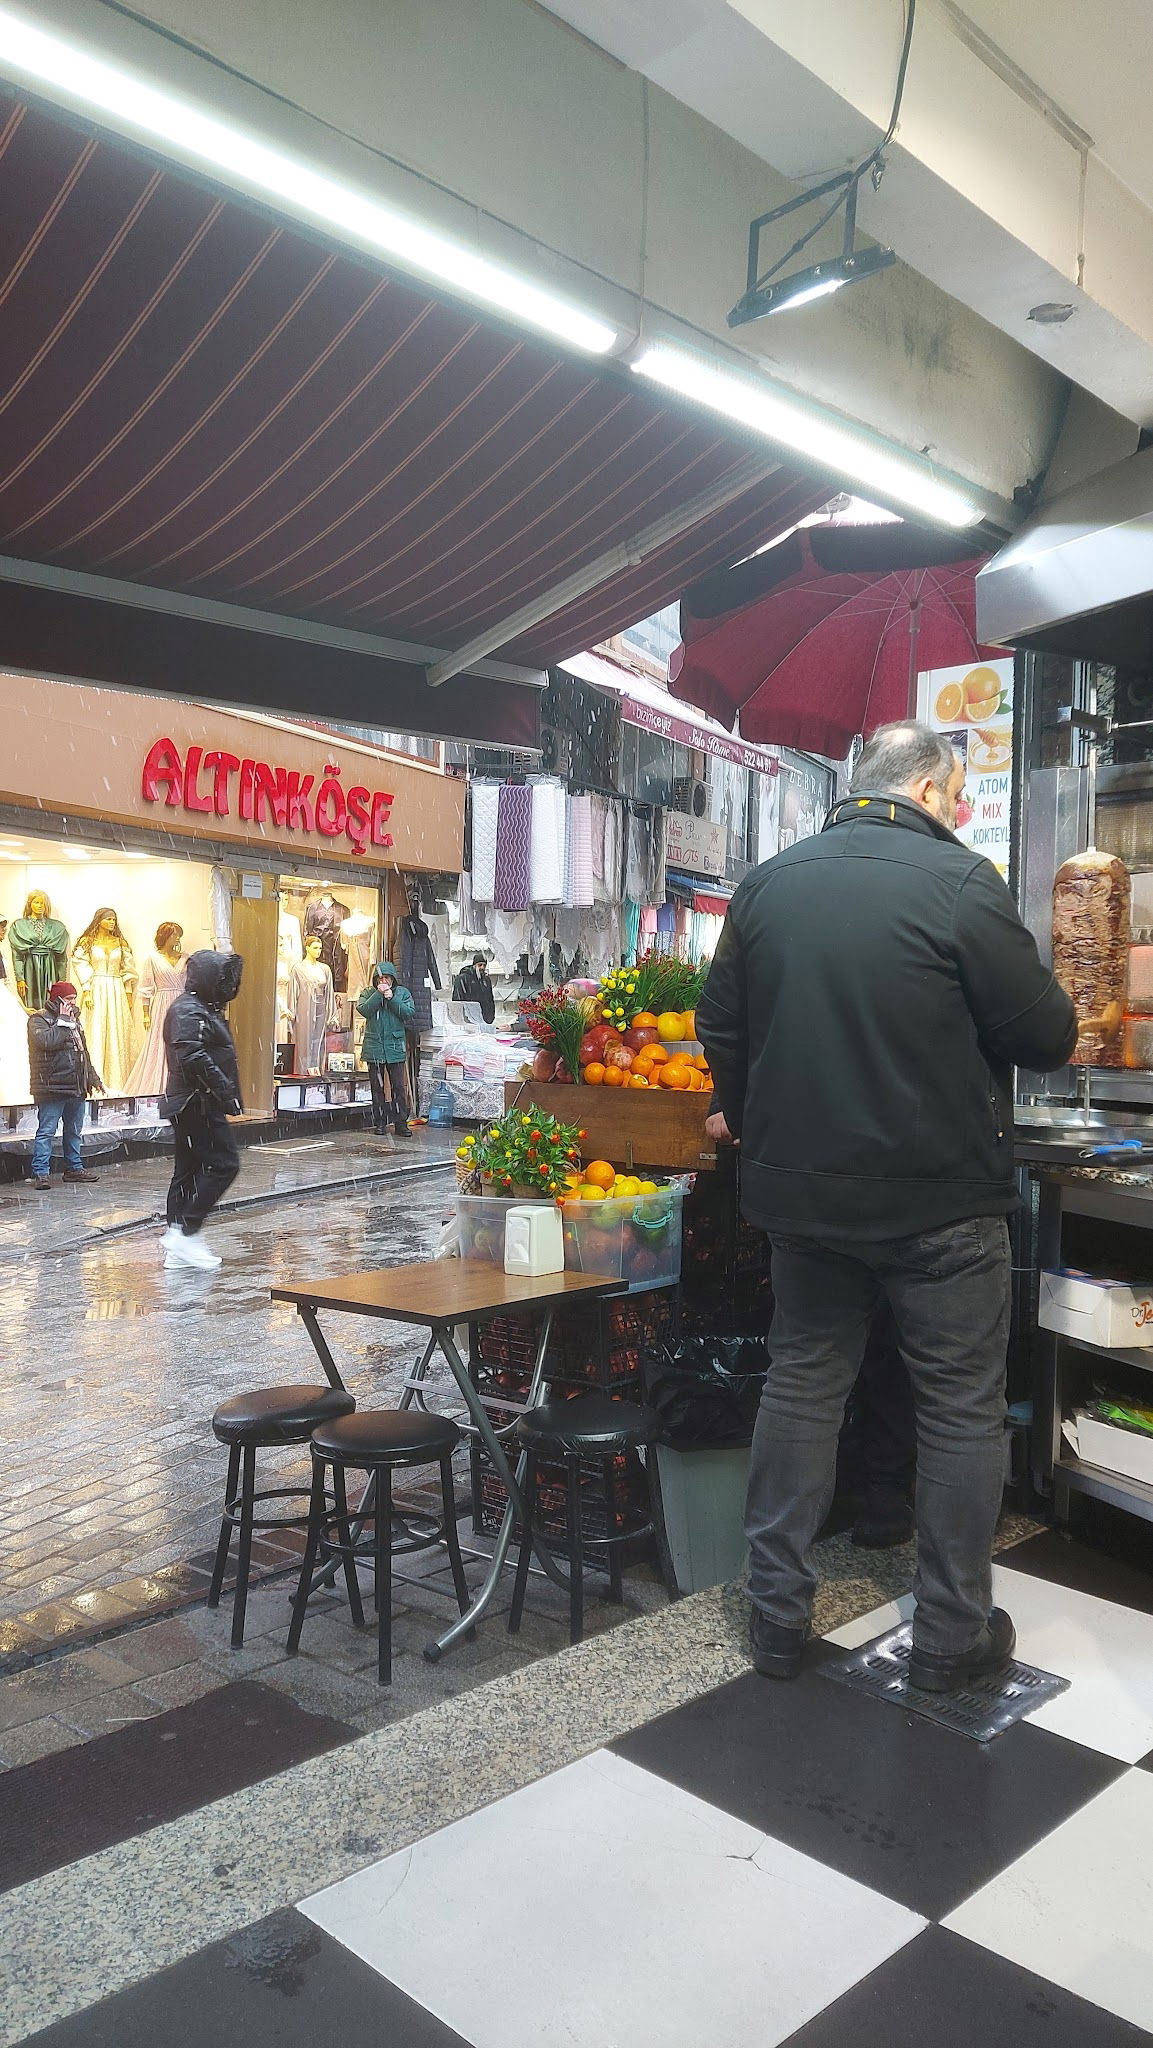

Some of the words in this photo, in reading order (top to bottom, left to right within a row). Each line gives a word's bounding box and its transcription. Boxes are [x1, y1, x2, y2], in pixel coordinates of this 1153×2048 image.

[744, 749, 756, 767] 522
[978, 777, 1008, 795] ATOM
[142, 737, 395, 855] ALTINKÖŞE
[982, 802, 1002, 819] MIX
[973, 826, 1010, 844] KOKTEYL
